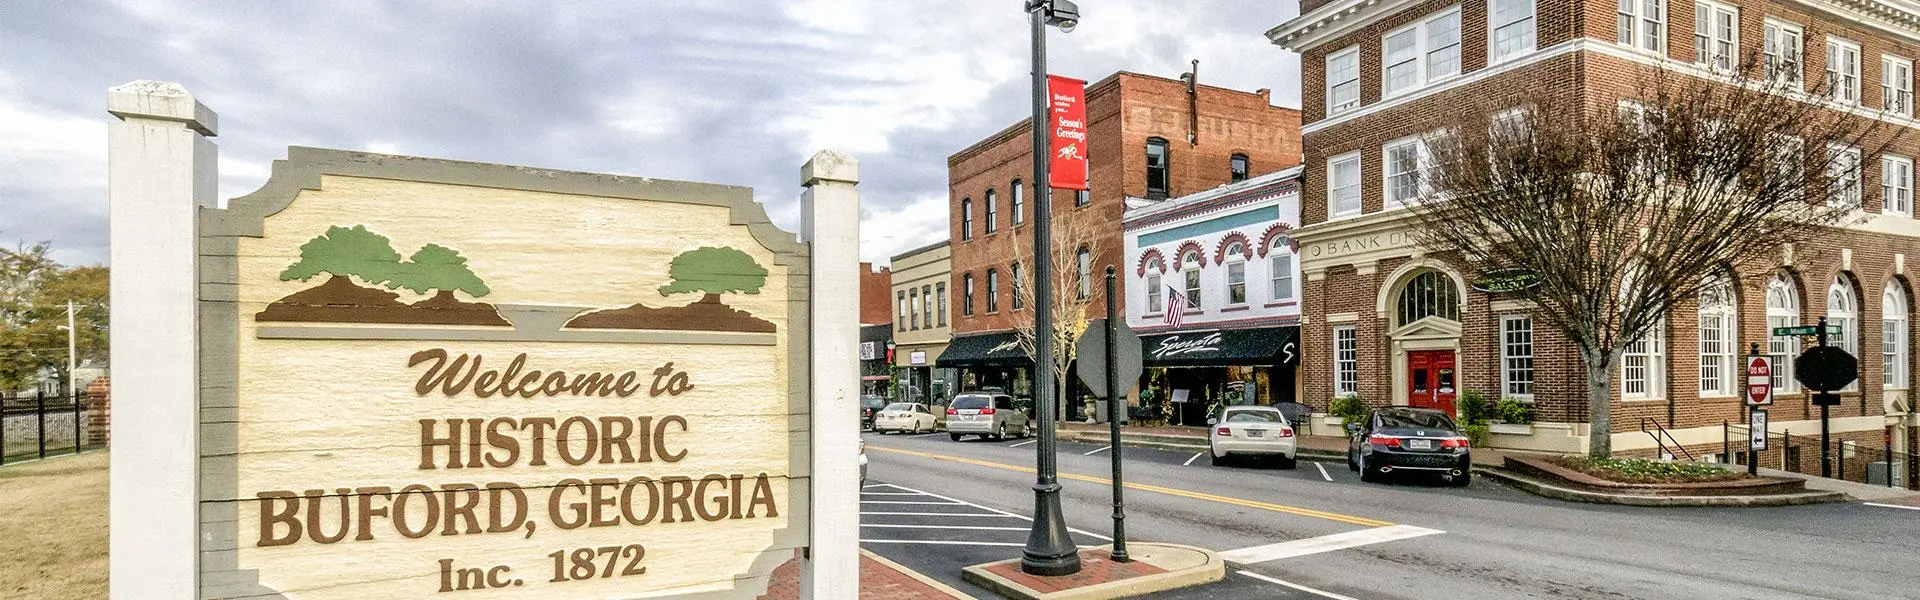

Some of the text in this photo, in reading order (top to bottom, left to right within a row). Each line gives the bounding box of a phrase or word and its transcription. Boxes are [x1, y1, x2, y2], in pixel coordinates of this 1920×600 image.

[1058, 116, 1083, 129] Season's
[1056, 127, 1085, 143] Greetings
[1327, 235, 1381, 255] BANK
[1282, 342, 1295, 364] S
[407, 348, 694, 398] Welcome to
[1750, 366, 1767, 374] DO NOT
[1752, 386, 1766, 394] ENTER
[1754, 415, 1763, 424] ONE
[418, 414, 689, 470] HISTORIC
[256, 472, 779, 547] BUFORD, GEORGIA
[438, 543, 646, 593] Inc. 1872
